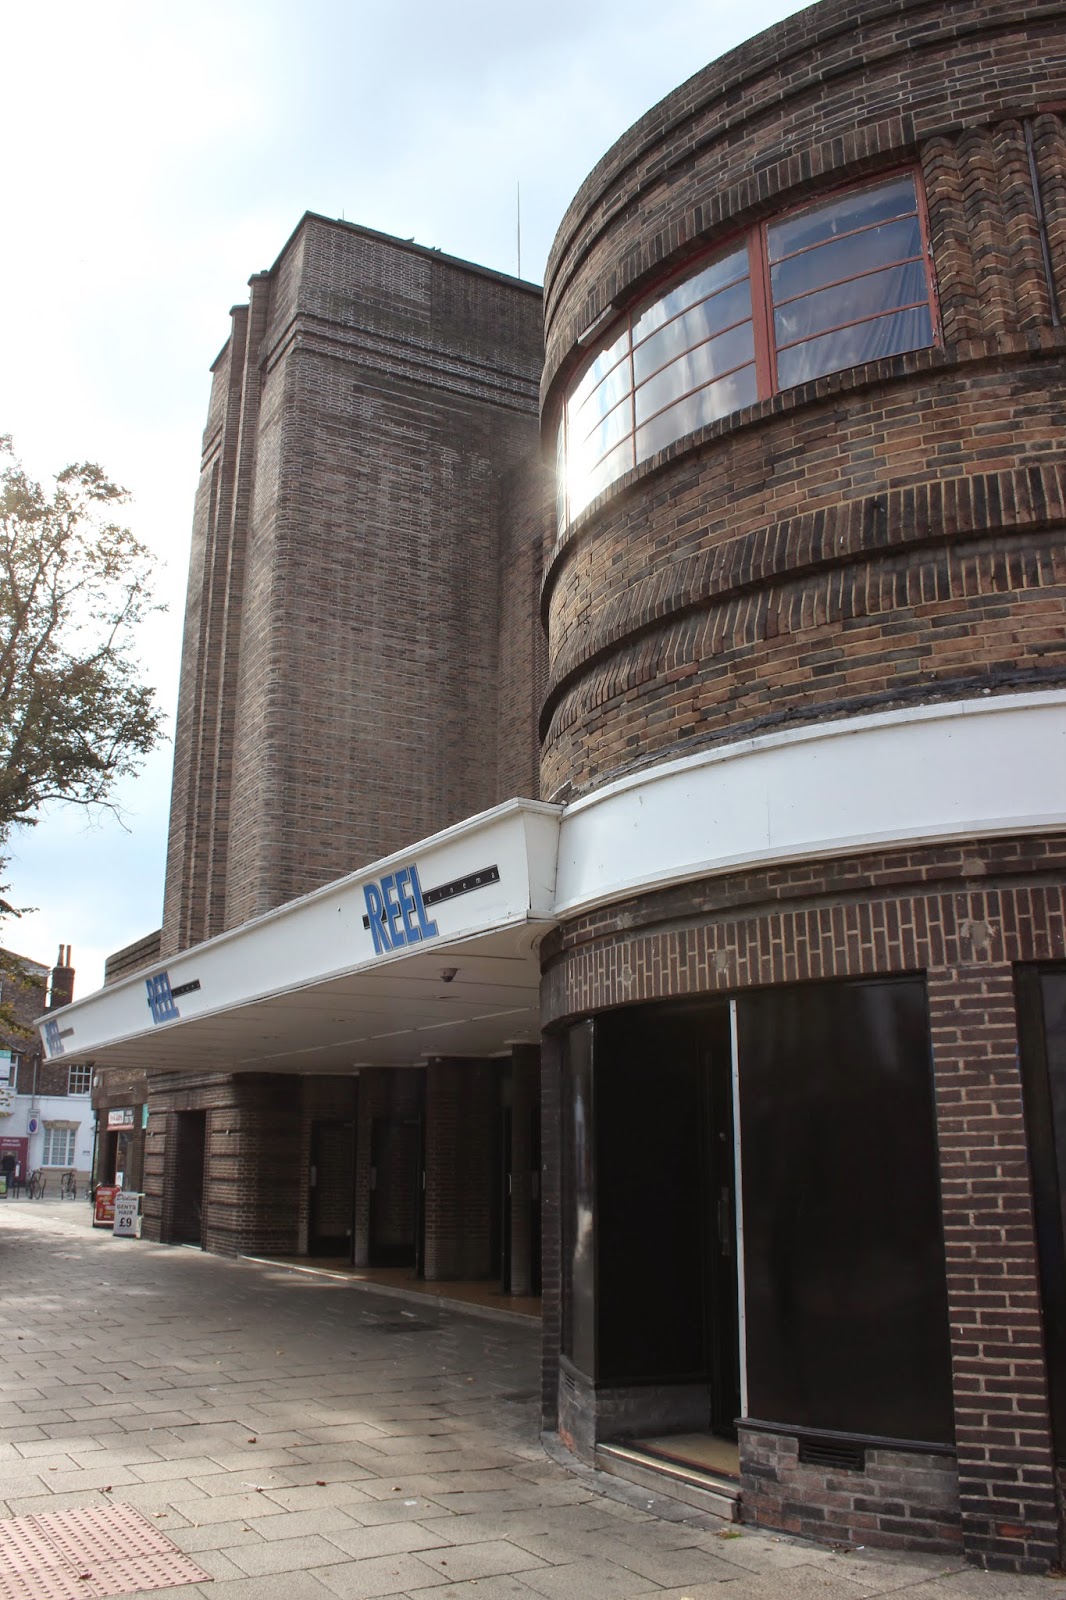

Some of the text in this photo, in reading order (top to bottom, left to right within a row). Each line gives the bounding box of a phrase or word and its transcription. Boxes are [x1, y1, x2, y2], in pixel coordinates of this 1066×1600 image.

[363, 863, 496, 956] REEL cinema
[146, 971, 180, 1025] REEL
[119, 1217, 132, 1228] £9
